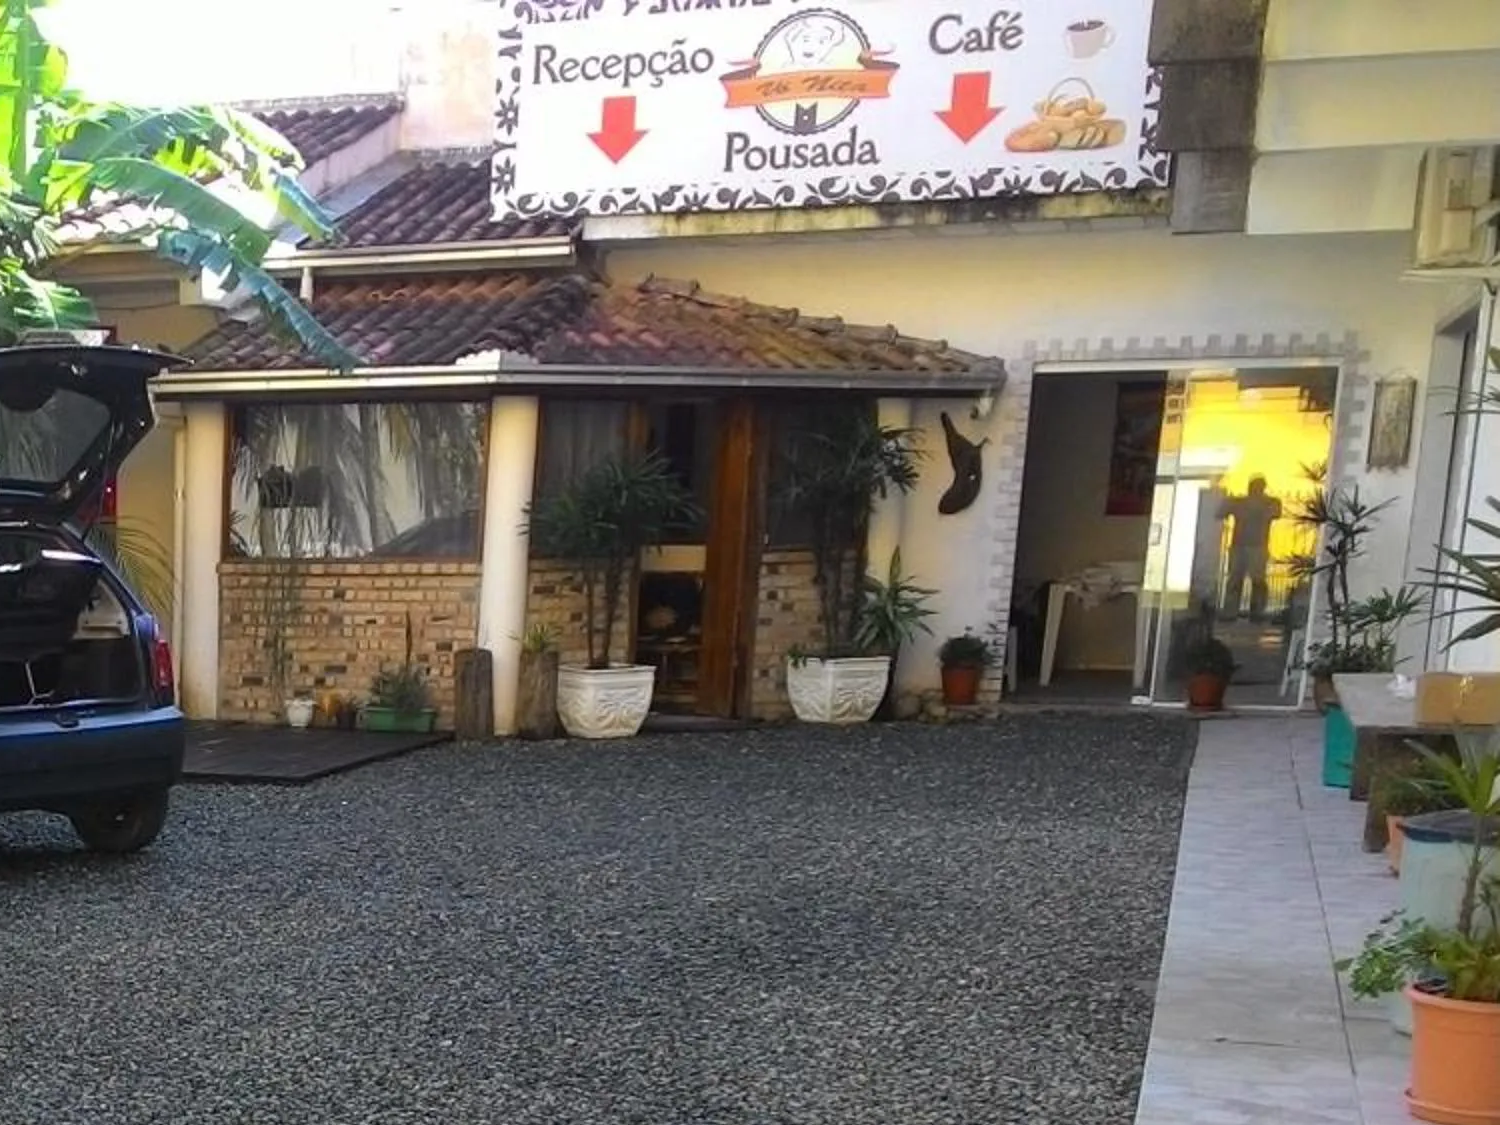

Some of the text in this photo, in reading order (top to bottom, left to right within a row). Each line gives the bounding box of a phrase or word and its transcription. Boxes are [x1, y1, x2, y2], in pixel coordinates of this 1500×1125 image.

[928, 10, 1024, 54] Café
[532, 38, 714, 87] Recepção
[724, 124, 881, 172] Pousada
